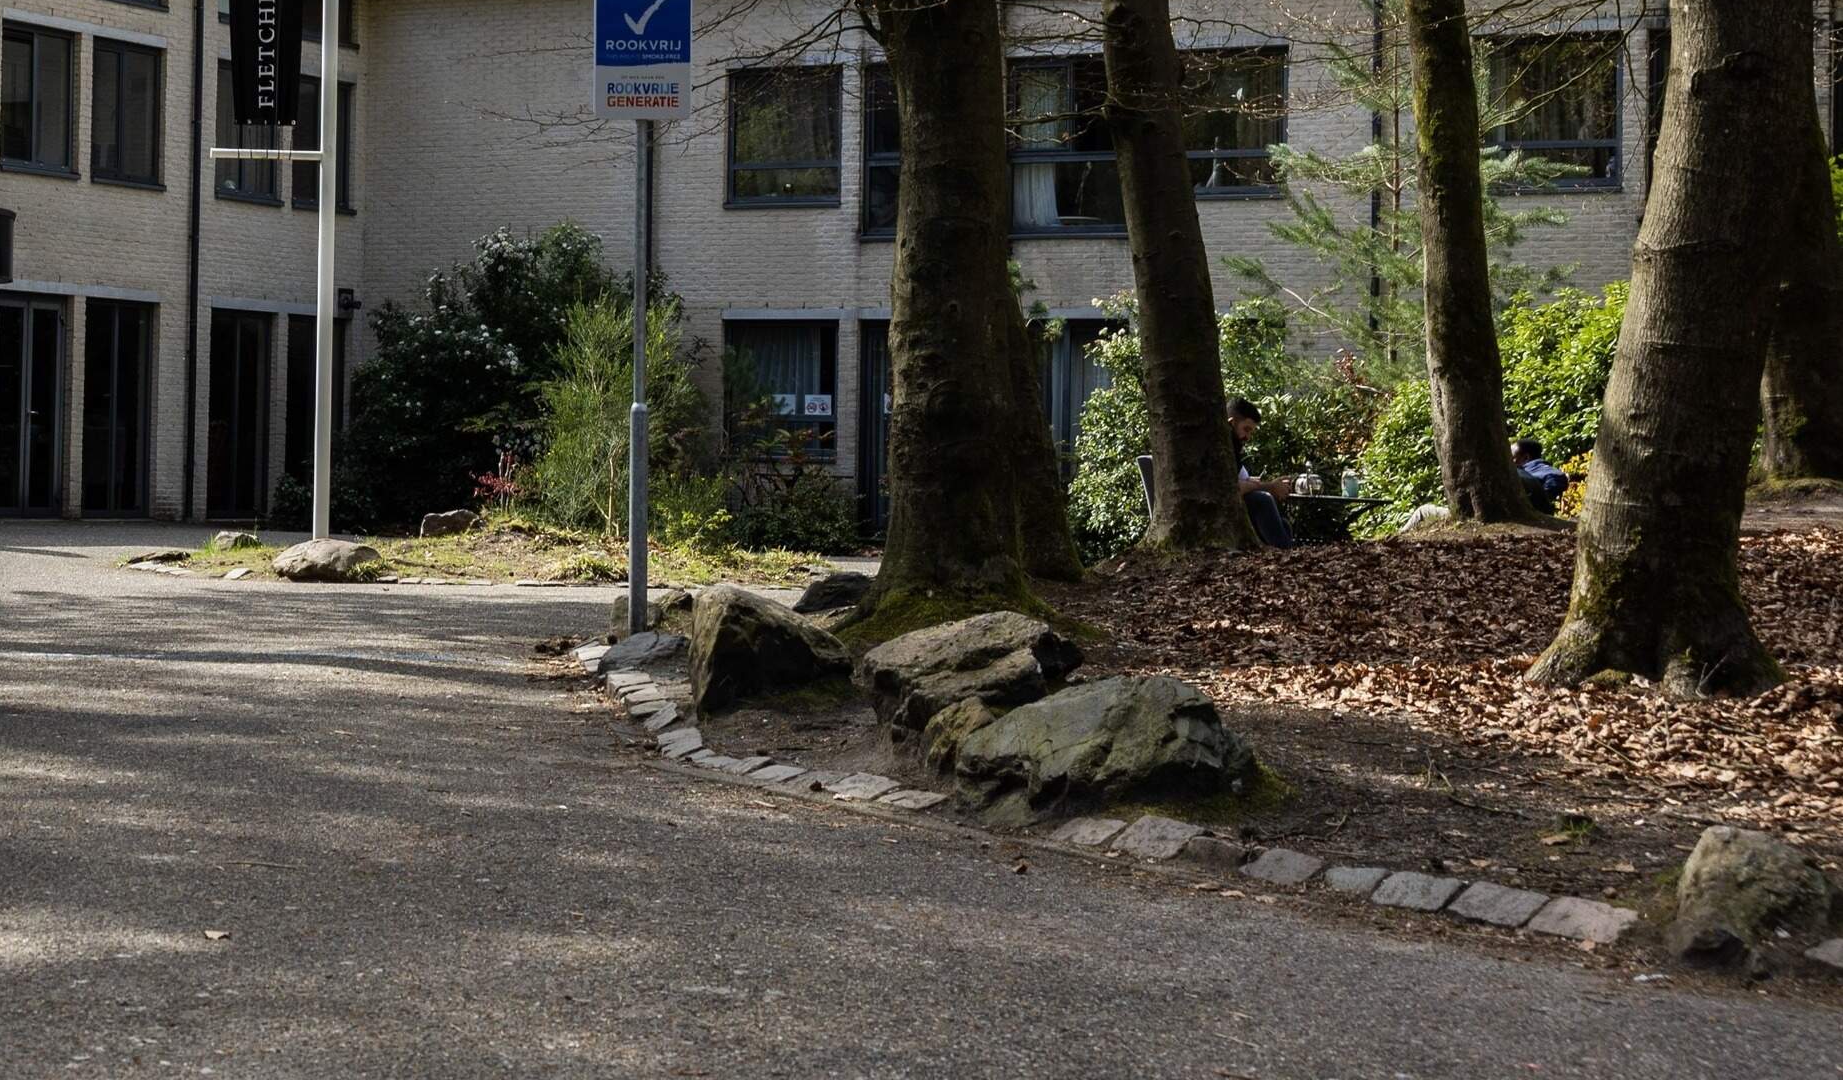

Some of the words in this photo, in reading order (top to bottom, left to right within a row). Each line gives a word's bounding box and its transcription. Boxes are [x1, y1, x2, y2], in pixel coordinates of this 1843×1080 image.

[605, 39, 681, 51] ROOKVRIJ
[606, 82, 680, 95] ROOKVRIJE
[606, 95, 680, 108] GENERATIE
